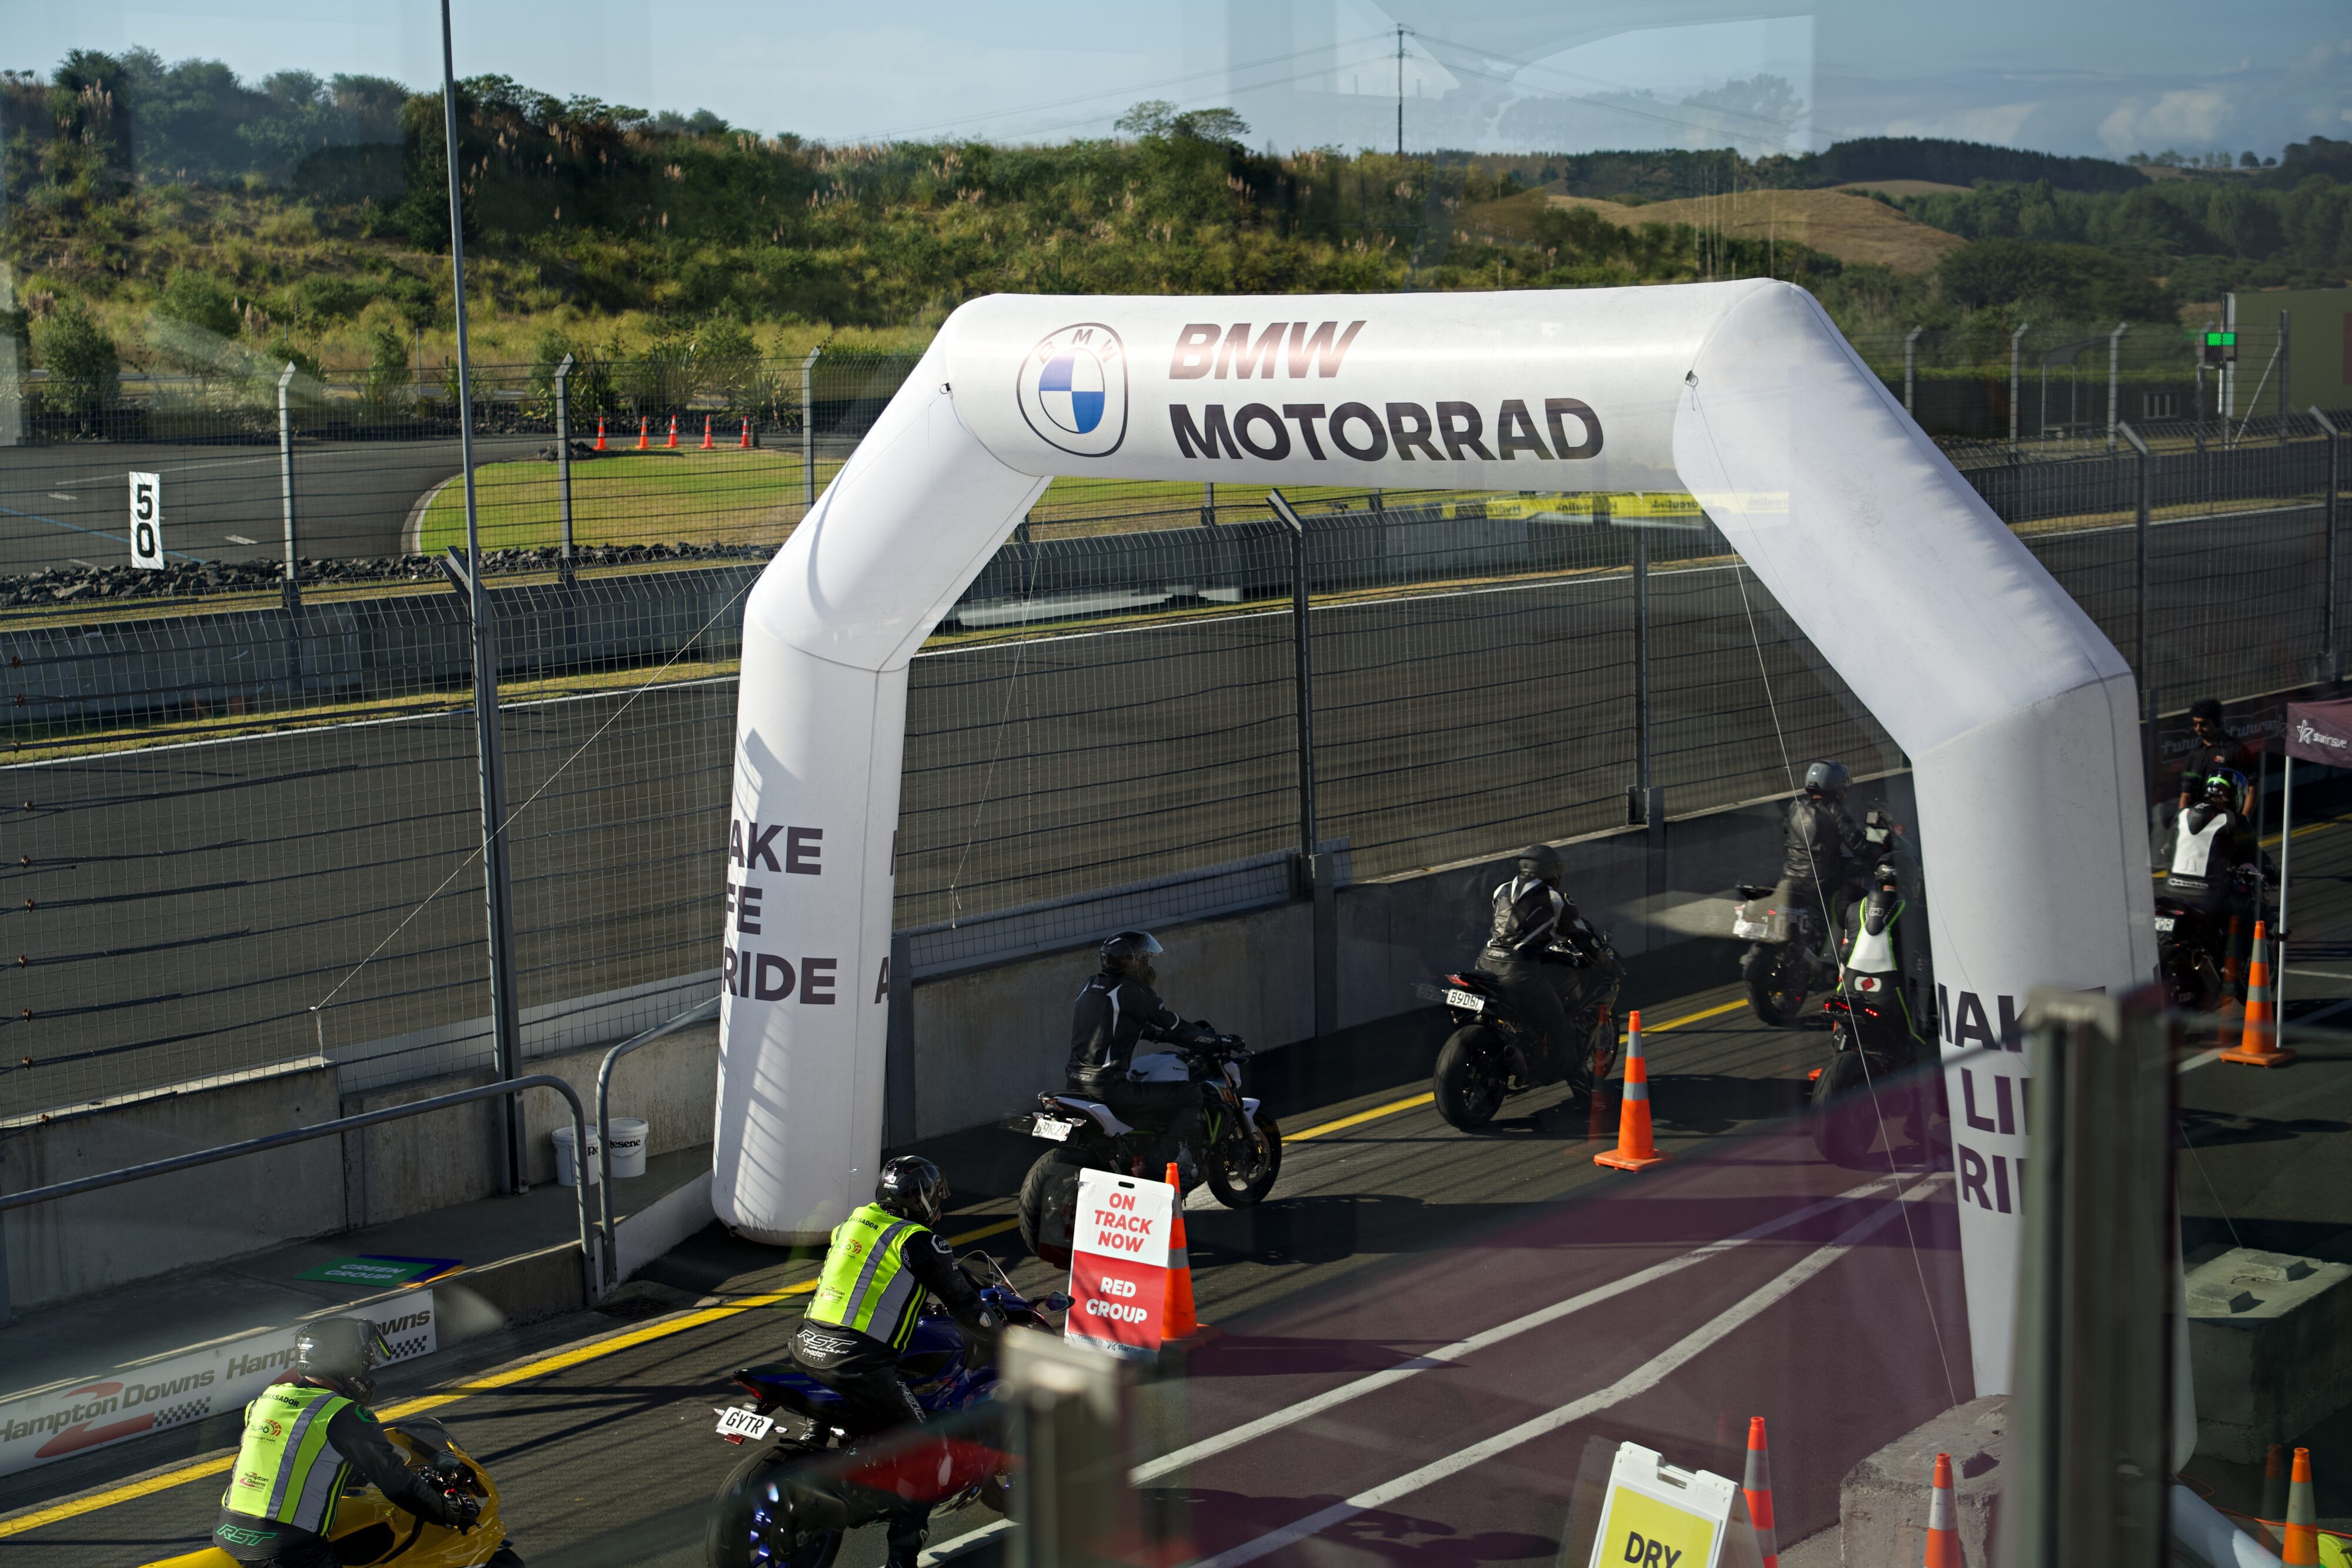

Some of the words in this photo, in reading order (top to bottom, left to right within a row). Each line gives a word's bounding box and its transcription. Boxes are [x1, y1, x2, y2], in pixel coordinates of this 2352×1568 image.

[1169, 320, 1367, 379] BMW
[1169, 397, 1604, 462] MOTORRAD
[723, 947, 837, 1005] RIDE
[1109, 1193, 1136, 1211] ON
[1094, 1209, 1154, 1235] TRACK
[1098, 1231, 1144, 1253] NOW
[325, 1270, 393, 1279] GROUP
[340, 1265, 406, 1273] GREEN
[1100, 1276, 1136, 1298] RED
[1085, 1299, 1148, 1324] GROUP
[797, 1329, 858, 1349] RST
[226, 1348, 297, 1380] Hamp
[122, 1369, 215, 1409] Downs
[726, 1412, 764, 1435] GYTR
[216, 1524, 278, 1546] RST
[1624, 1531, 1682, 1568] DRY
